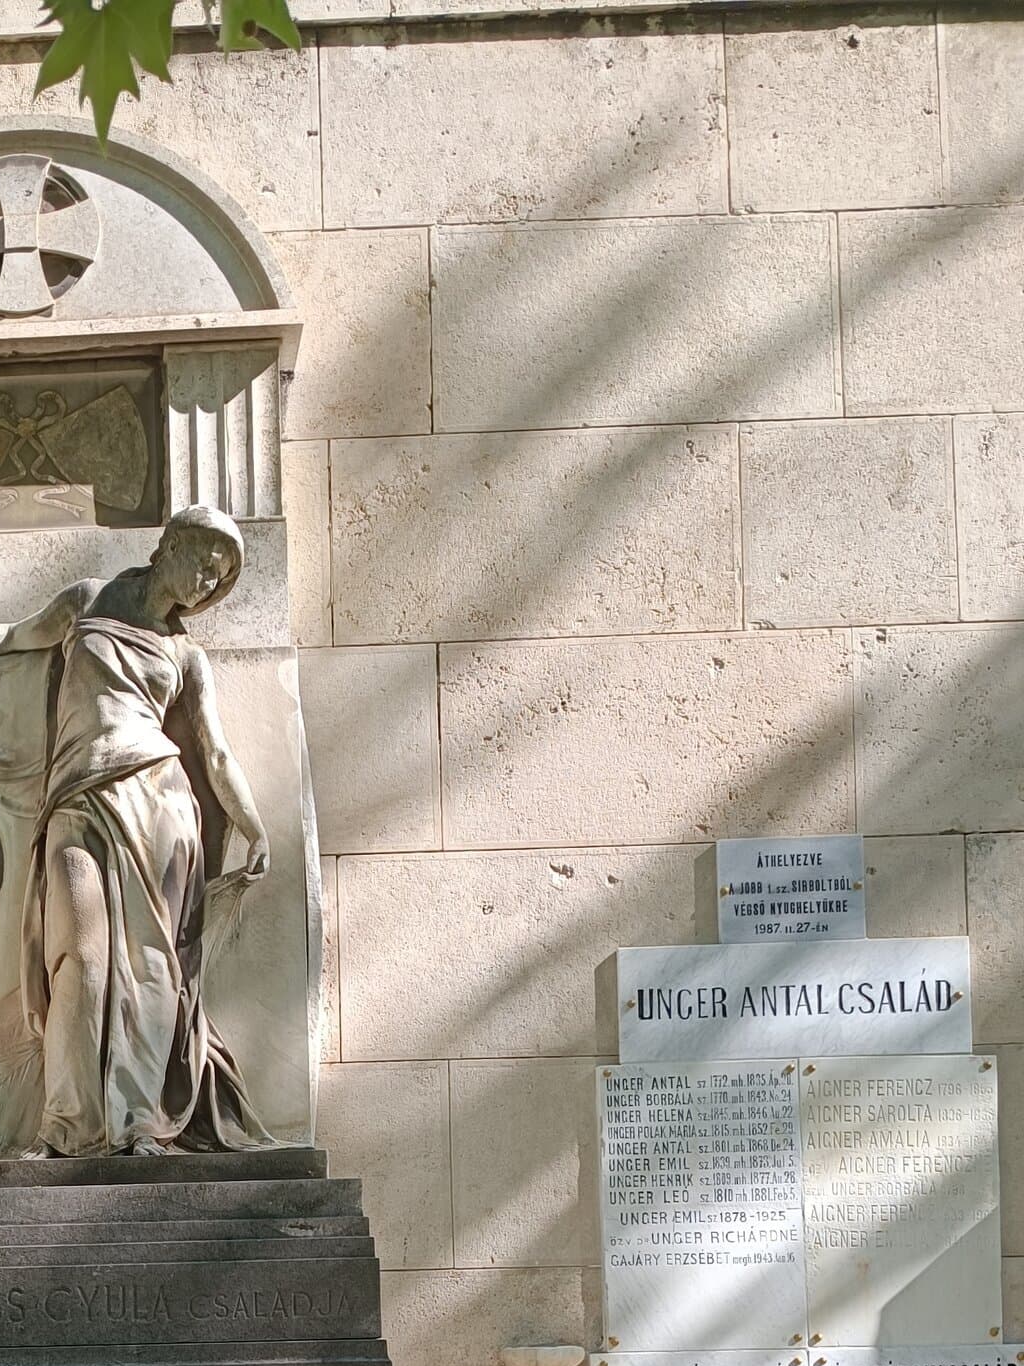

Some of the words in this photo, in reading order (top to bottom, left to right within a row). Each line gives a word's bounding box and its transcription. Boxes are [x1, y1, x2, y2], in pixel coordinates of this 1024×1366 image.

[757, 852, 822, 868] ÁTHELYEZVE
[729, 883, 735, 895] A
[740, 881, 762, 894] JOBB
[792, 876, 851, 892] SIRBOLTBÓL
[637, 987, 728, 1020] UNGER
[740, 984, 830, 1017] ANTAL
[838, 968, 952, 1015] CSALÁD
[606, 1077, 643, 1092] UNGER
[651, 1076, 691, 1090] ANTAL
[807, 1079, 862, 1097] AIGNER
[867, 1079, 933, 1096] FERENCZ
[606, 1094, 641, 1108] UNGER
[607, 1110, 642, 1123] UNGER
[648, 1109, 693, 1122] HELENA
[807, 1104, 862, 1123] AIGNER
[867, 1104, 932, 1122] SAROLTA
[607, 1126, 636, 1139] UNGER
[807, 1131, 862, 1150] AIGNER
[608, 1142, 647, 1156] UNGER
[653, 1141, 692, 1154] ANTAL
[609, 1158, 651, 1172] UNGER
[659, 1157, 690, 1171] EMIL
[839, 1156, 895, 1174] AIGNER
[609, 1175, 648, 1188] UNGER
[651, 1173, 693, 1188] HENRIK
[609, 1191, 654, 1205] UNGER
[620, 1211, 667, 1225] UNGER
[675, 1210, 705, 1223] EMIL
[810, 1204, 865, 1222] AIGNER
[651, 1232, 703, 1245] UNGER
[711, 1224, 798, 1244] RICHÁRDNÉ
[610, 1250, 661, 1267] GAJÁRY
[666, 1249, 731, 1265] ERZSÉBET
